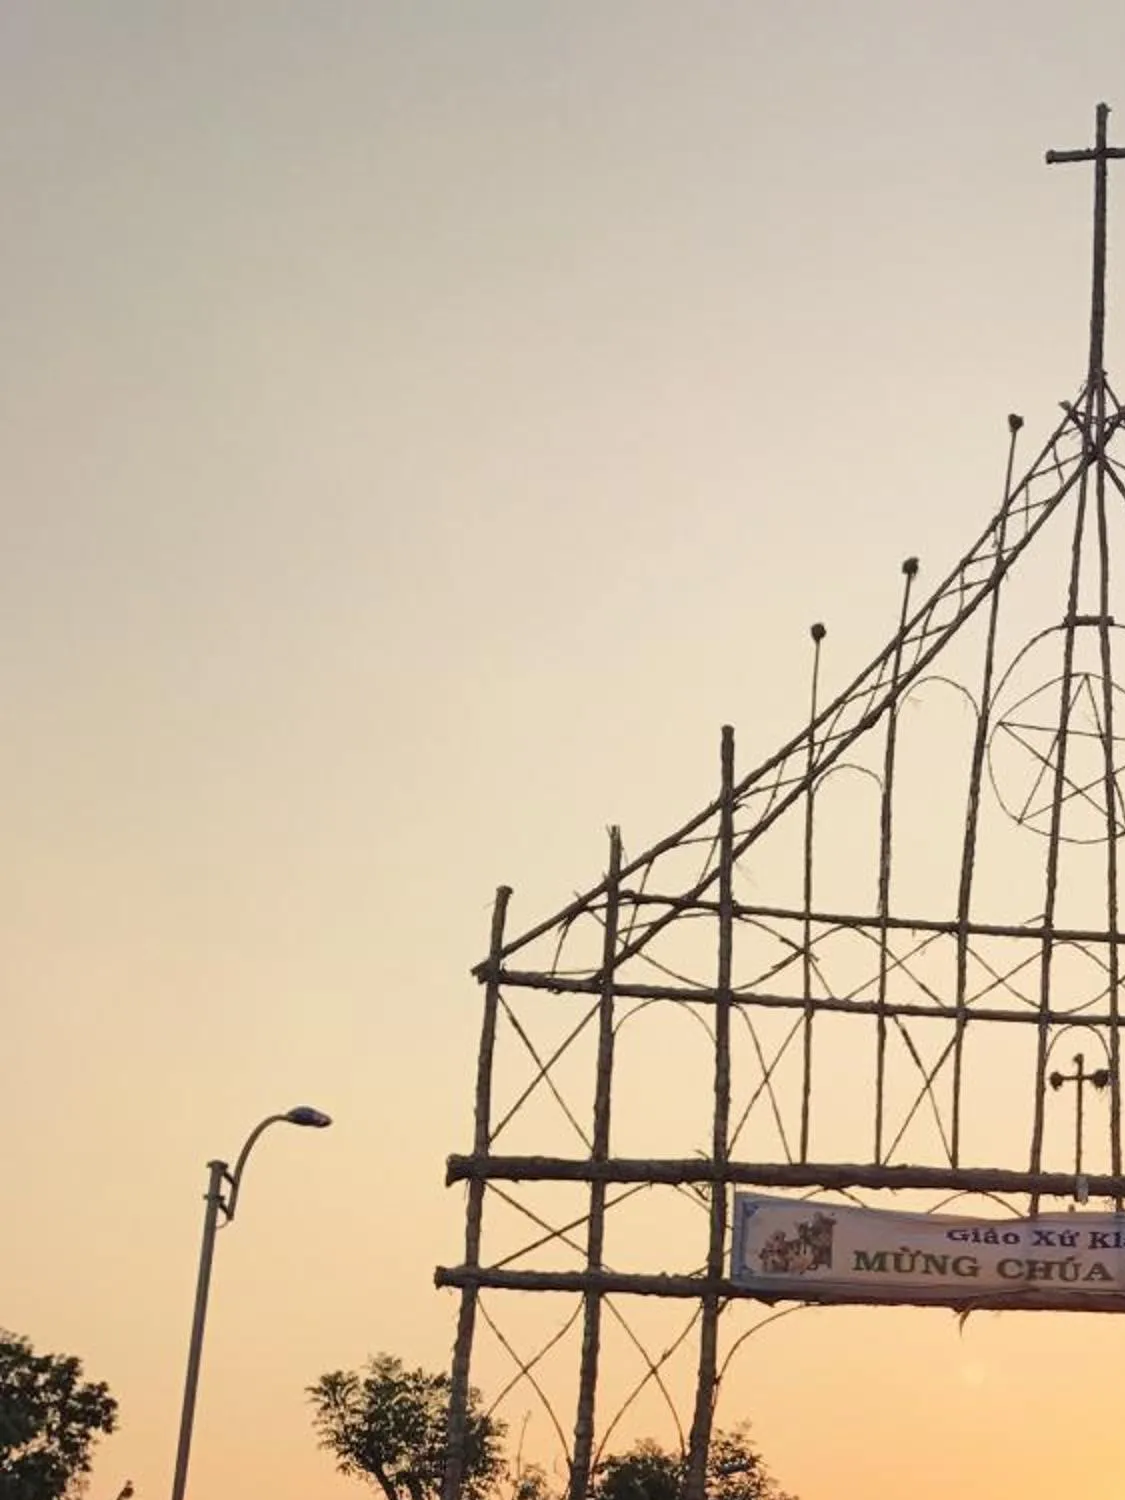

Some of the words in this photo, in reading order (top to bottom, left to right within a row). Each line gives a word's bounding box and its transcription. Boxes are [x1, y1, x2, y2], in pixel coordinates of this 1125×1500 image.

[1031, 1229, 1081, 1247] Xứ
[852, 1246, 981, 1278] MỪNG
[996, 1256, 1115, 1282] CHÚA
